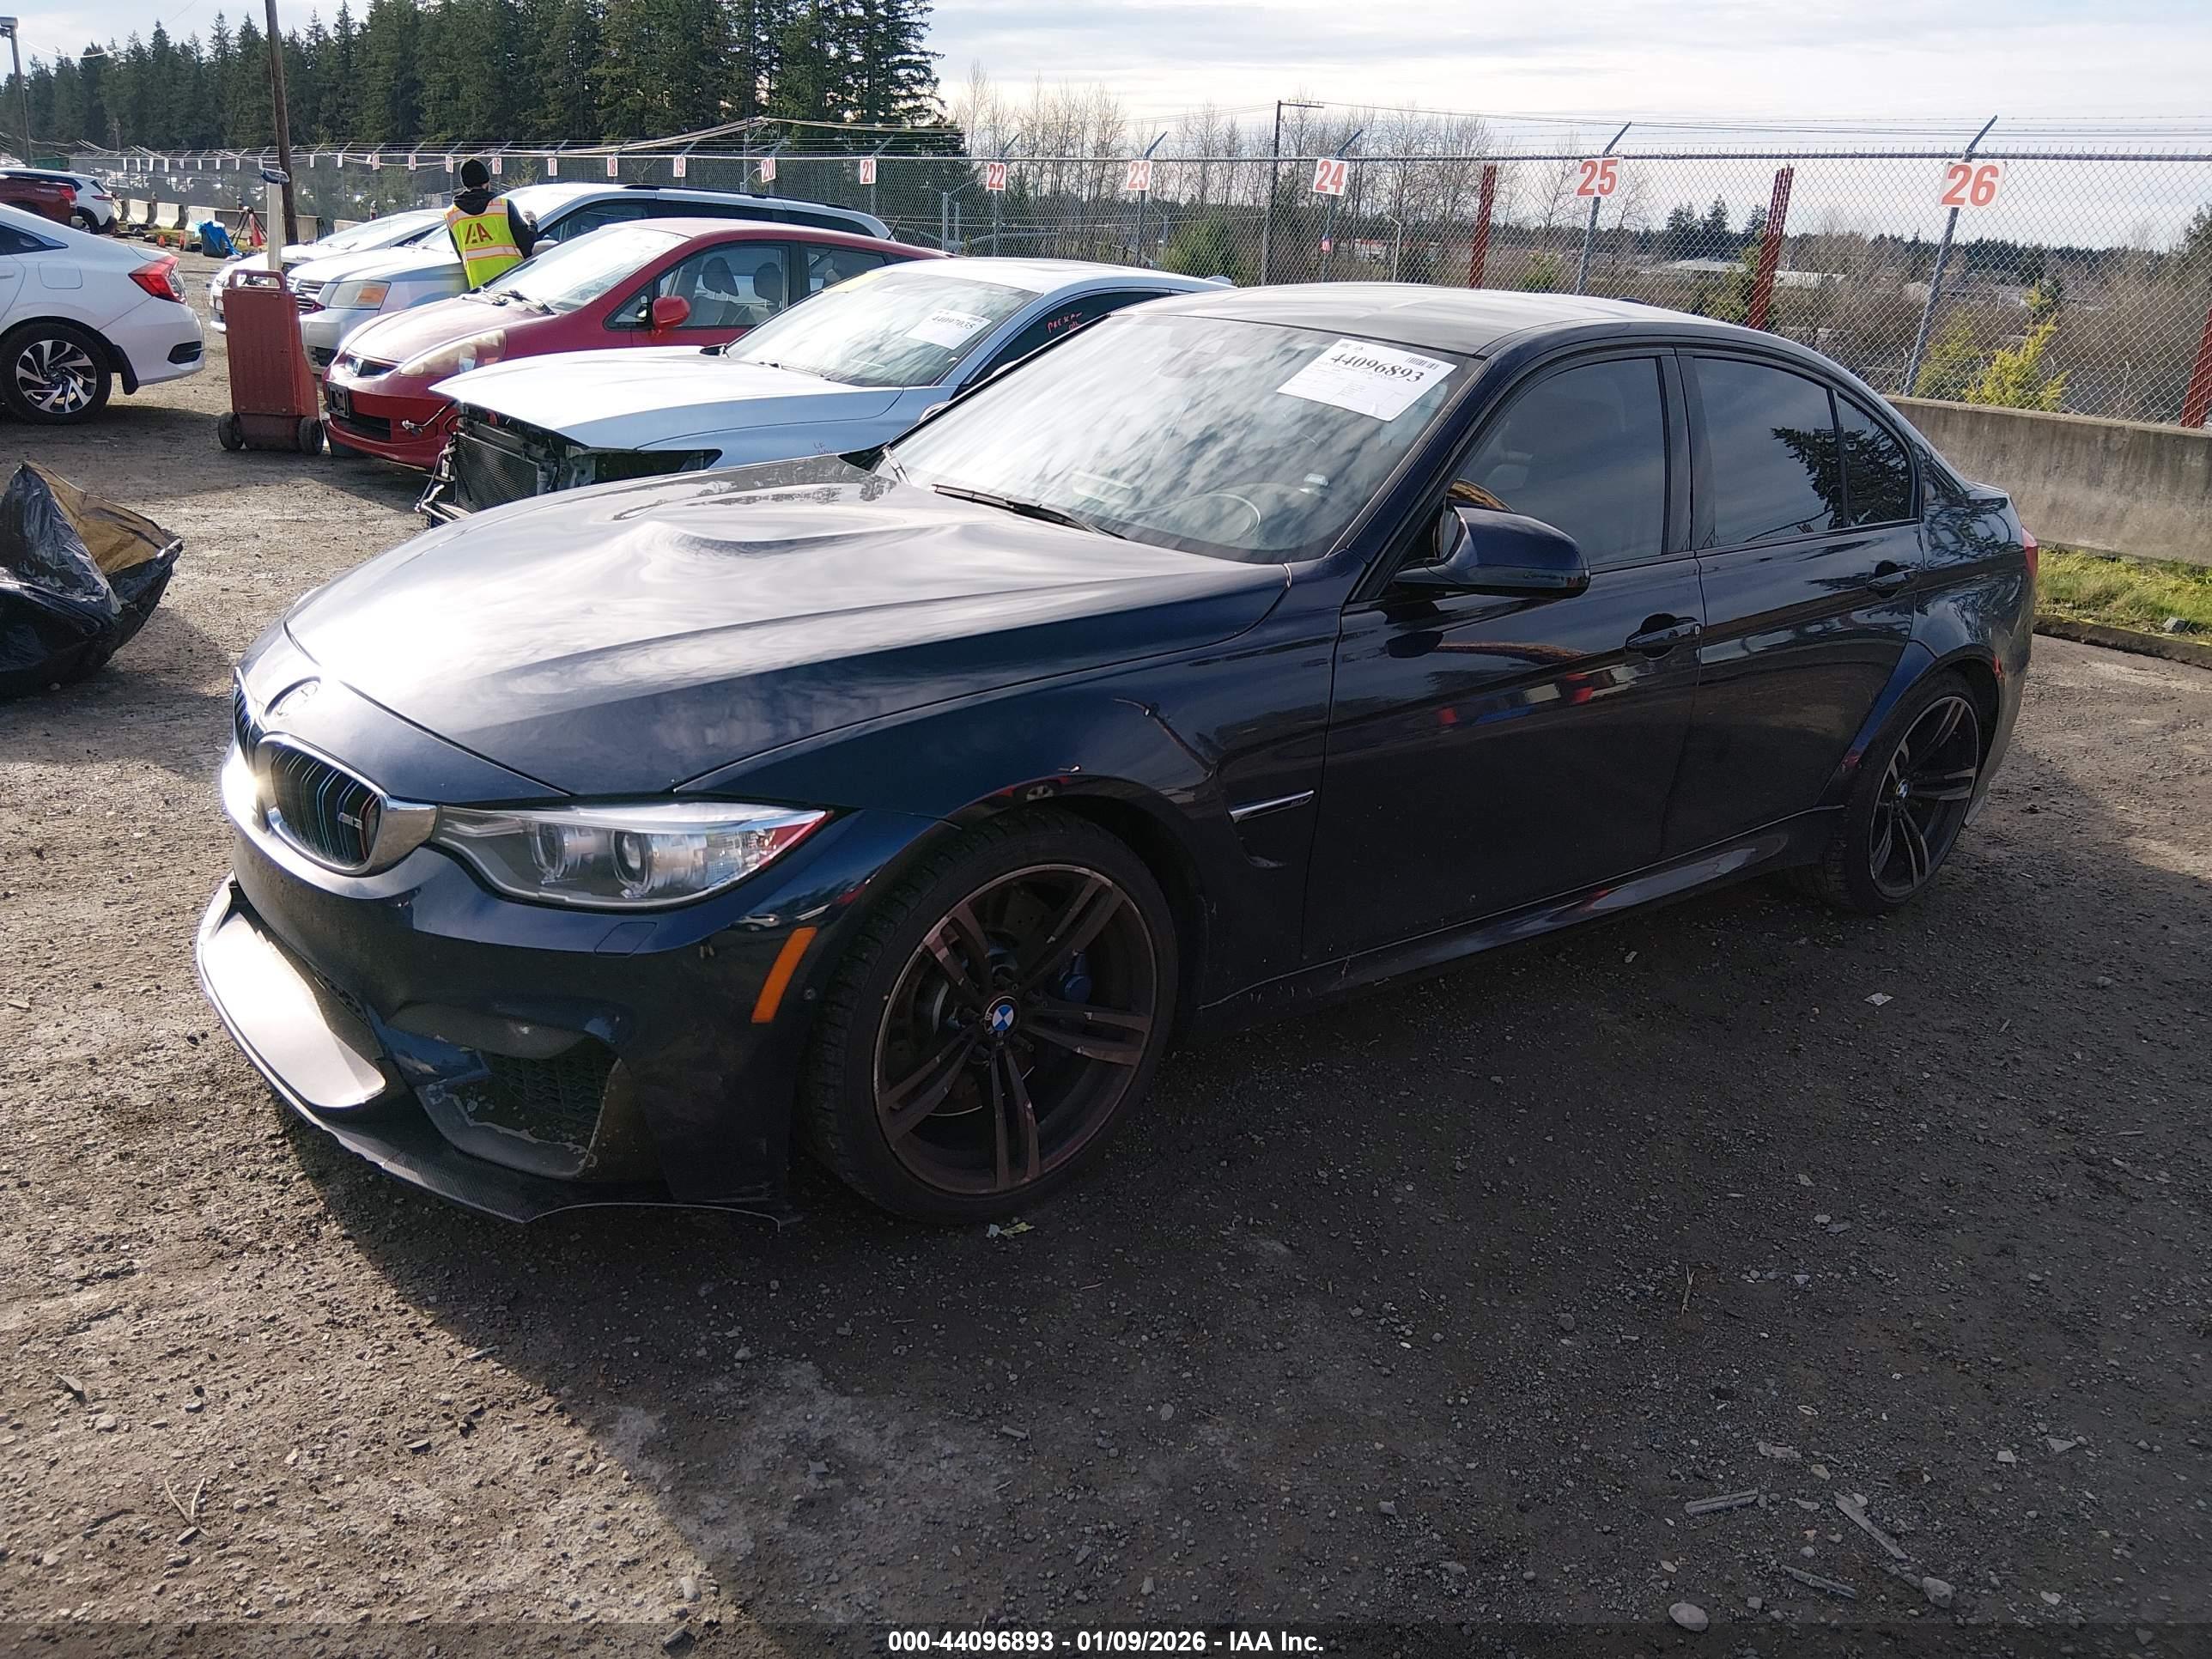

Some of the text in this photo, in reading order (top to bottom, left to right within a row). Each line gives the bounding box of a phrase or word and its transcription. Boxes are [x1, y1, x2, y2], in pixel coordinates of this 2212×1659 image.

[550, 158, 556, 174] 17
[609, 158, 617, 175] 18
[676, 157, 684, 176] 19
[763, 159, 774, 180] 20
[862, 160, 873, 183] 21
[988, 163, 1005, 189] 22
[1127, 161, 1151, 189] 23
[1315, 160, 1344, 194] 24
[1577, 159, 1619, 197] 25
[1941, 164, 1999, 207] 26
[1330, 352, 1425, 383] 44096893
